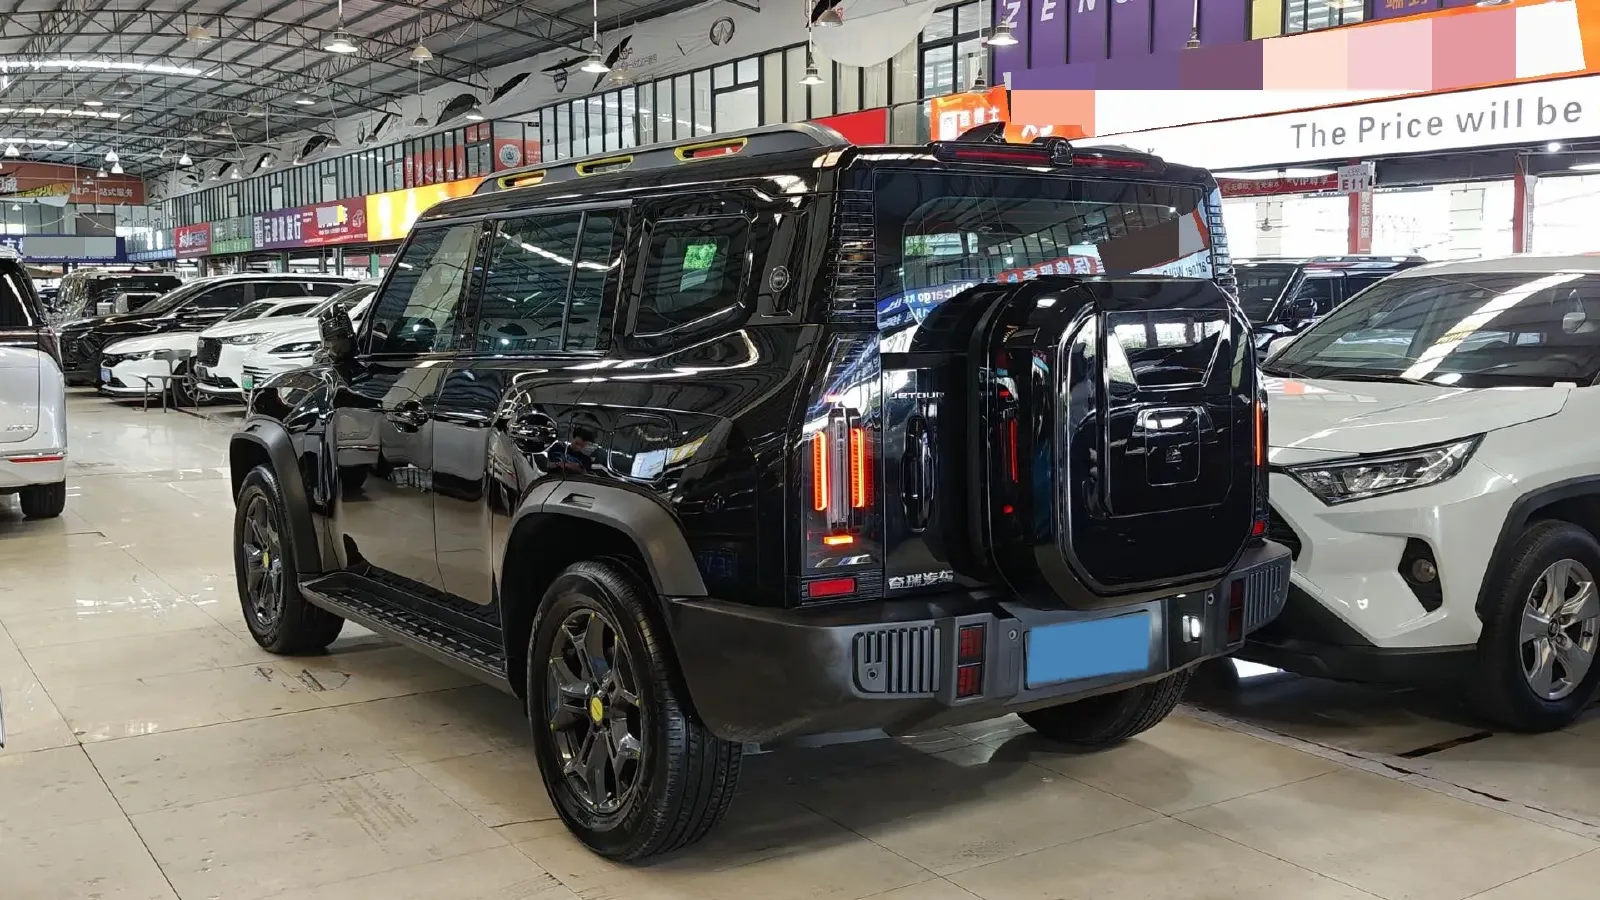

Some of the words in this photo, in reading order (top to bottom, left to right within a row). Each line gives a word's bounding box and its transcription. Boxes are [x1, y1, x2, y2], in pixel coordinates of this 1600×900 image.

[1006, 0, 1132, 29] ZEN
[1290, 123, 1346, 149] The
[1359, 112, 1443, 143] Price
[1455, 98, 1523, 133] will
[1537, 96, 1582, 125] be
[1342, 178, 1364, 191] E11
[889, 391, 945, 400] JETOUR
